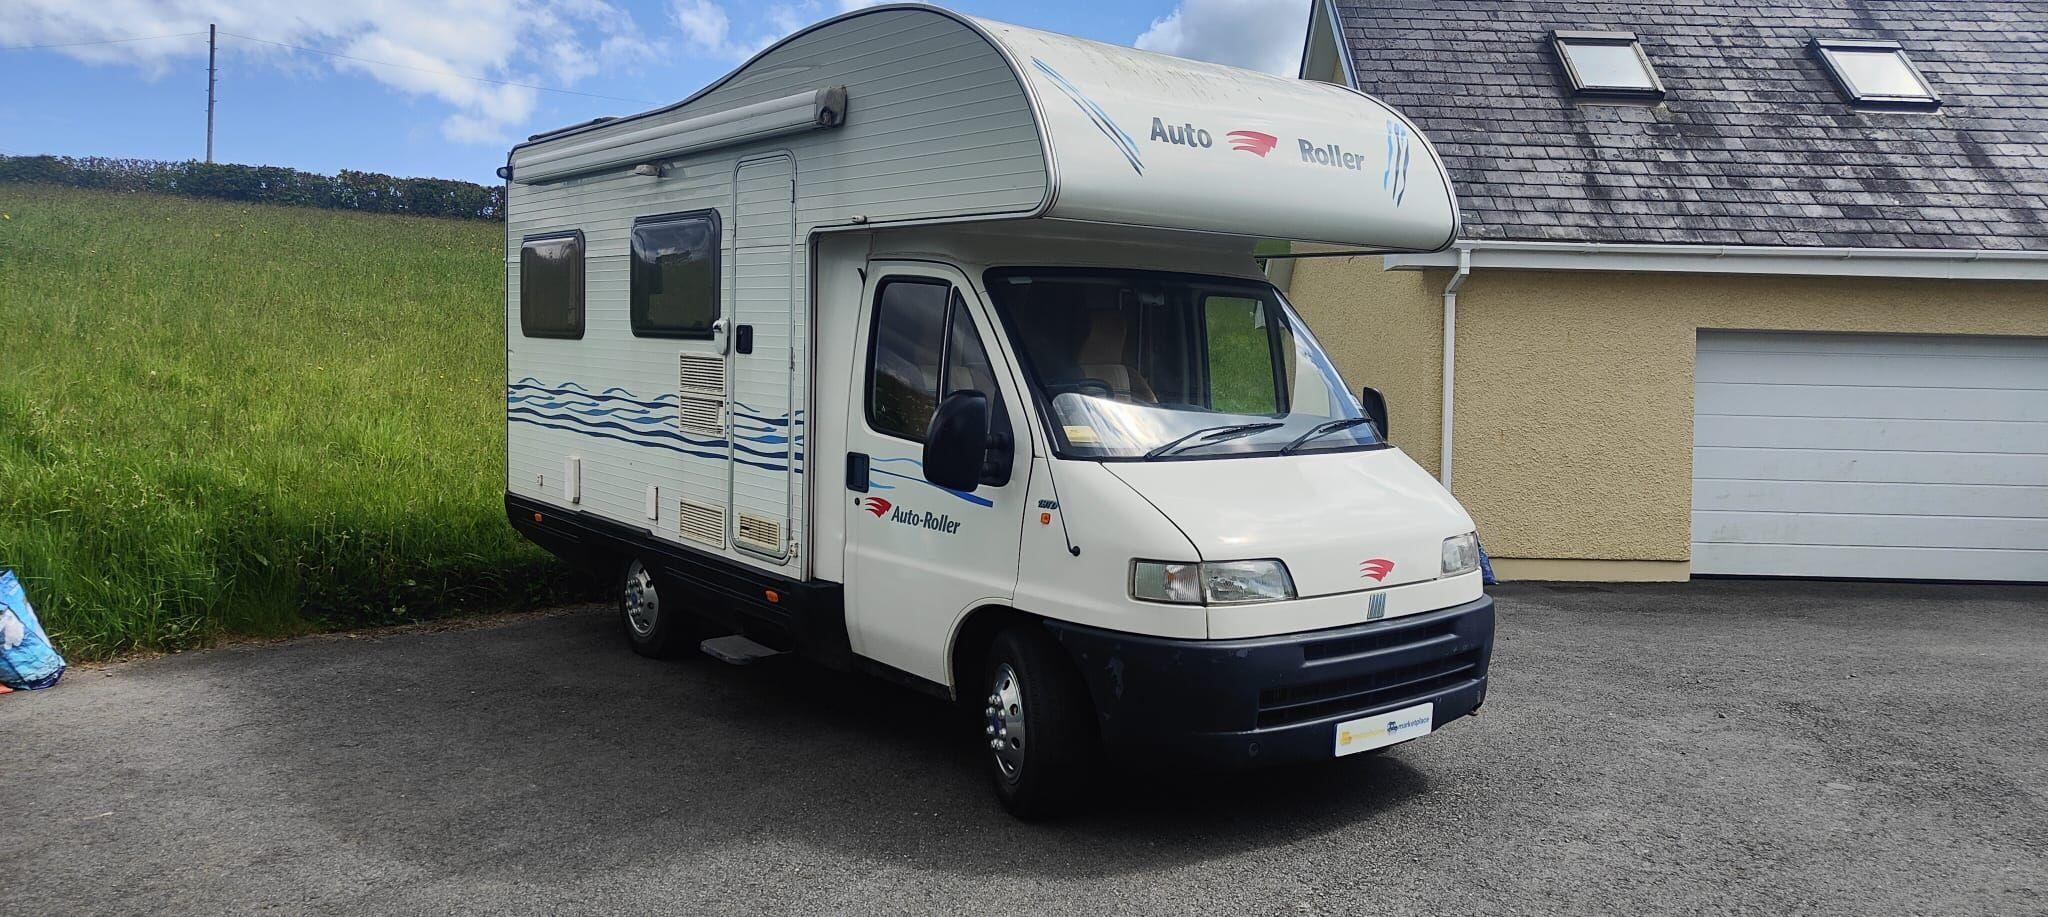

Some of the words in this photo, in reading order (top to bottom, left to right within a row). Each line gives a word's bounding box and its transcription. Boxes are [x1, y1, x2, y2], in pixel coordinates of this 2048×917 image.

[1151, 117, 1213, 148] Auto
[1298, 138, 1364, 171] Roller
[891, 505, 961, 535] Auto-Roller
